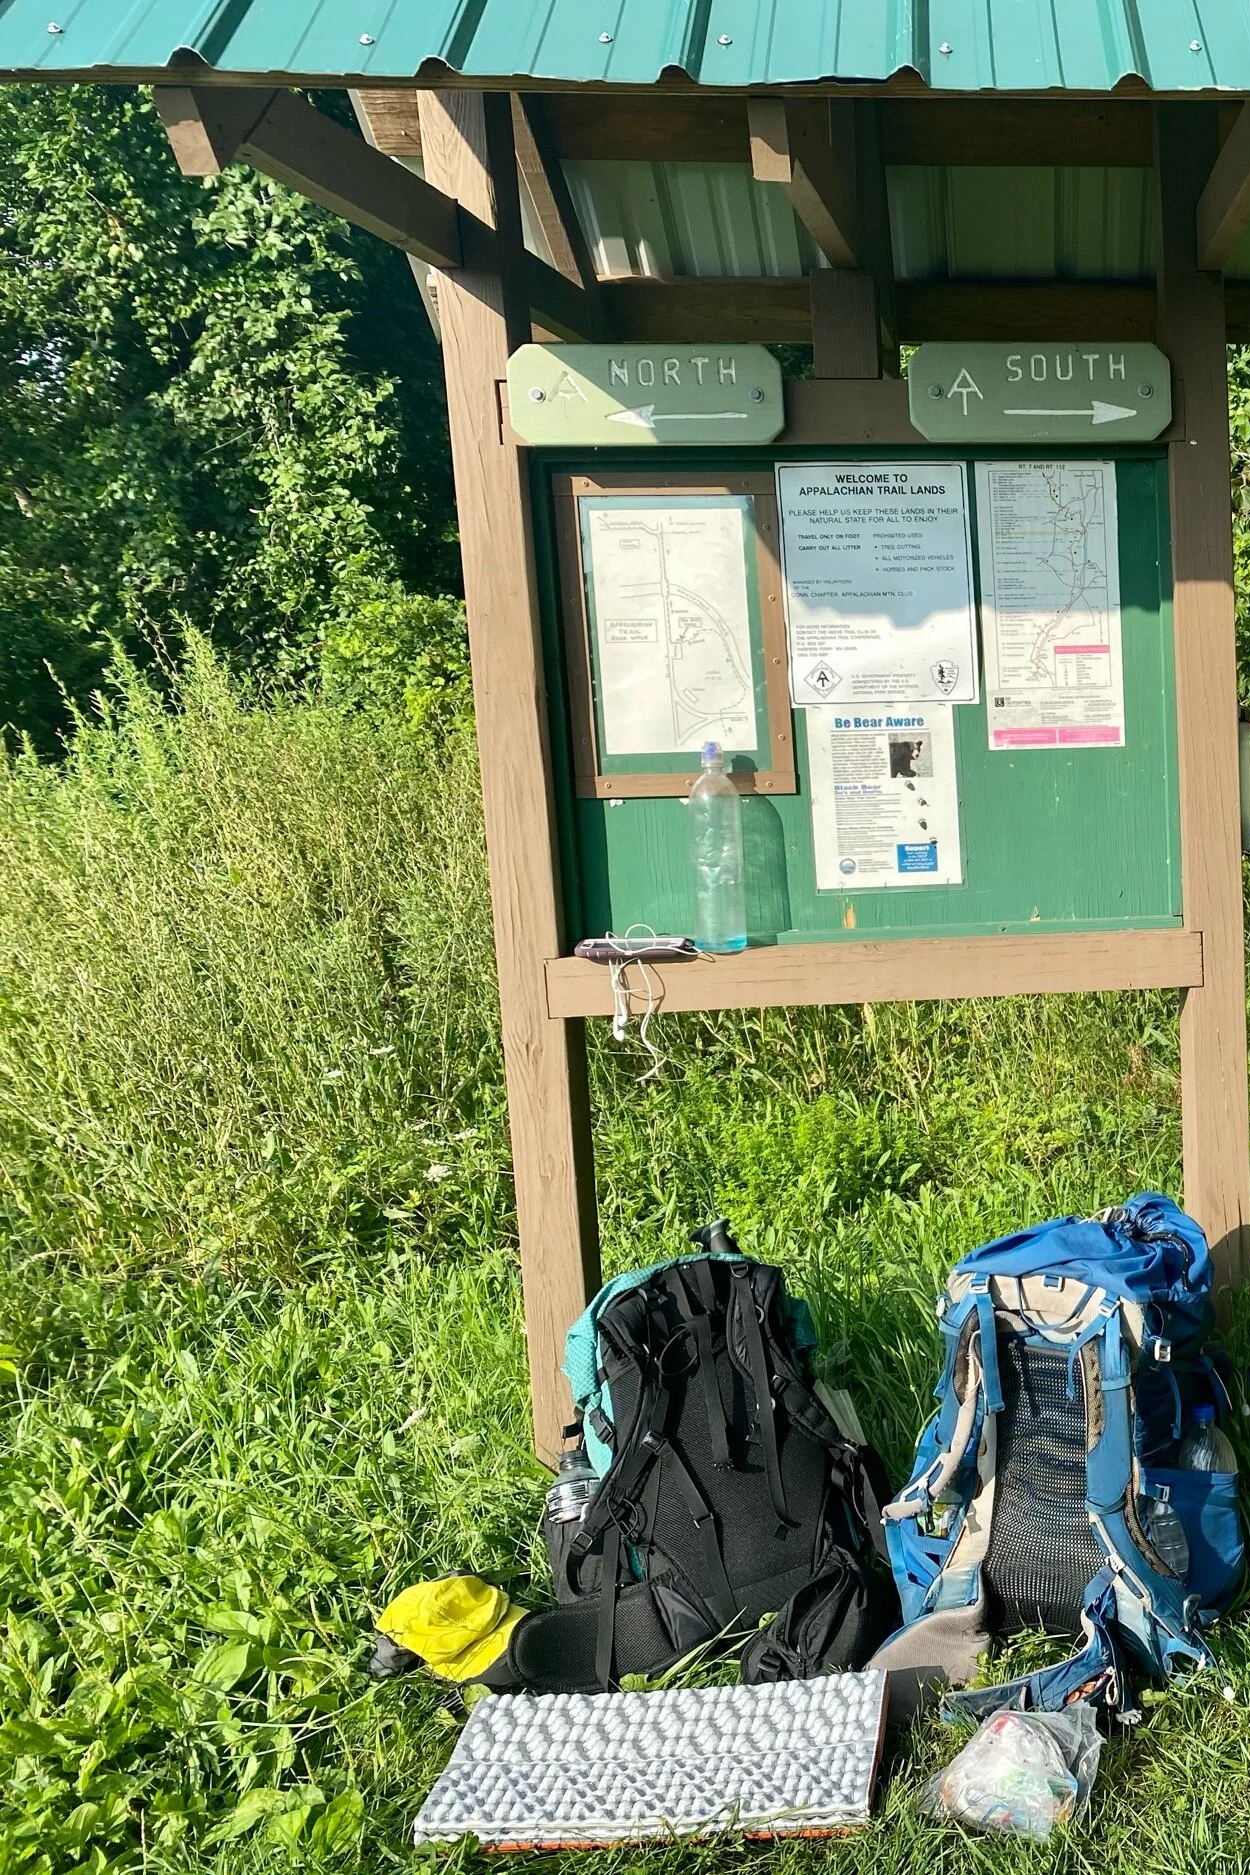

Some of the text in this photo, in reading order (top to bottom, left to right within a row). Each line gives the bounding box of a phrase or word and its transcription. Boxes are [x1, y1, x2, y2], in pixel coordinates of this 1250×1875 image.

[608, 357, 737, 387] NORTH
[1006, 353, 1126, 382] SOUTH
[835, 473, 908, 483] WELCOME TO
[799, 485, 946, 496] APPALACHIAN TRAIL LANDS
[835, 716, 925, 728] Be Bear Aware
